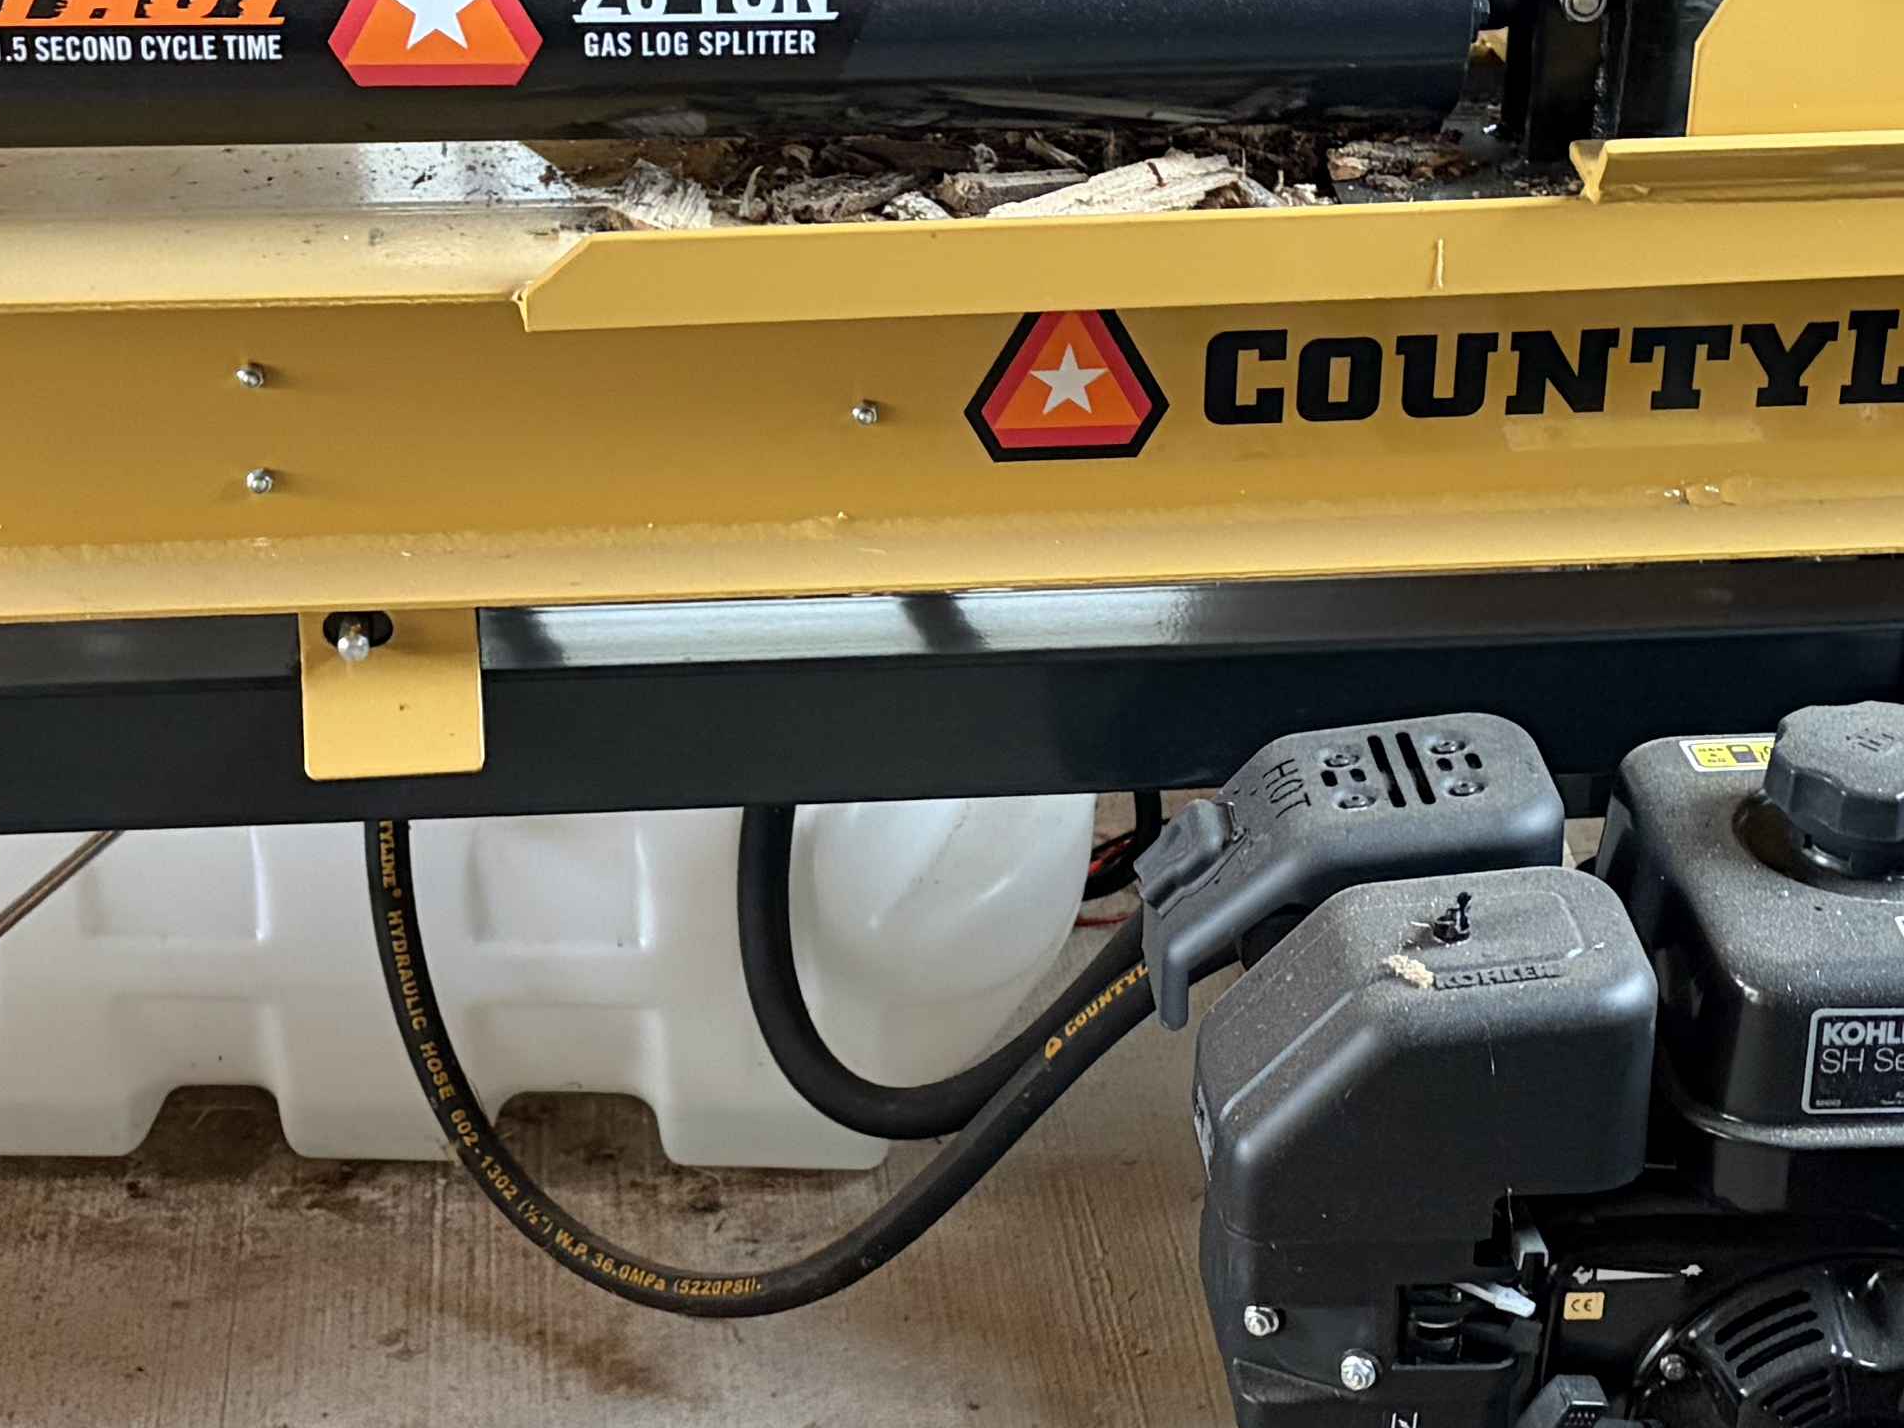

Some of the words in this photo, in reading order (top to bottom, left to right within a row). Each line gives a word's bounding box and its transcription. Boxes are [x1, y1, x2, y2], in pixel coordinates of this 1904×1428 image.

[35, 35, 133, 62] SECOND
[141, 34, 217, 61] CYCLE
[223, 33, 283, 61] TIME
[584, 30, 632, 58] GAS
[641, 30, 689, 57] LOG
[698, 28, 816, 56] SPLITTER
[1261, 758, 1312, 819] HOT
[387, 909, 428, 1031] HYDRAULIC
[419, 1040, 457, 1100] HOSE
[1820, 1047, 1865, 1074] SH
